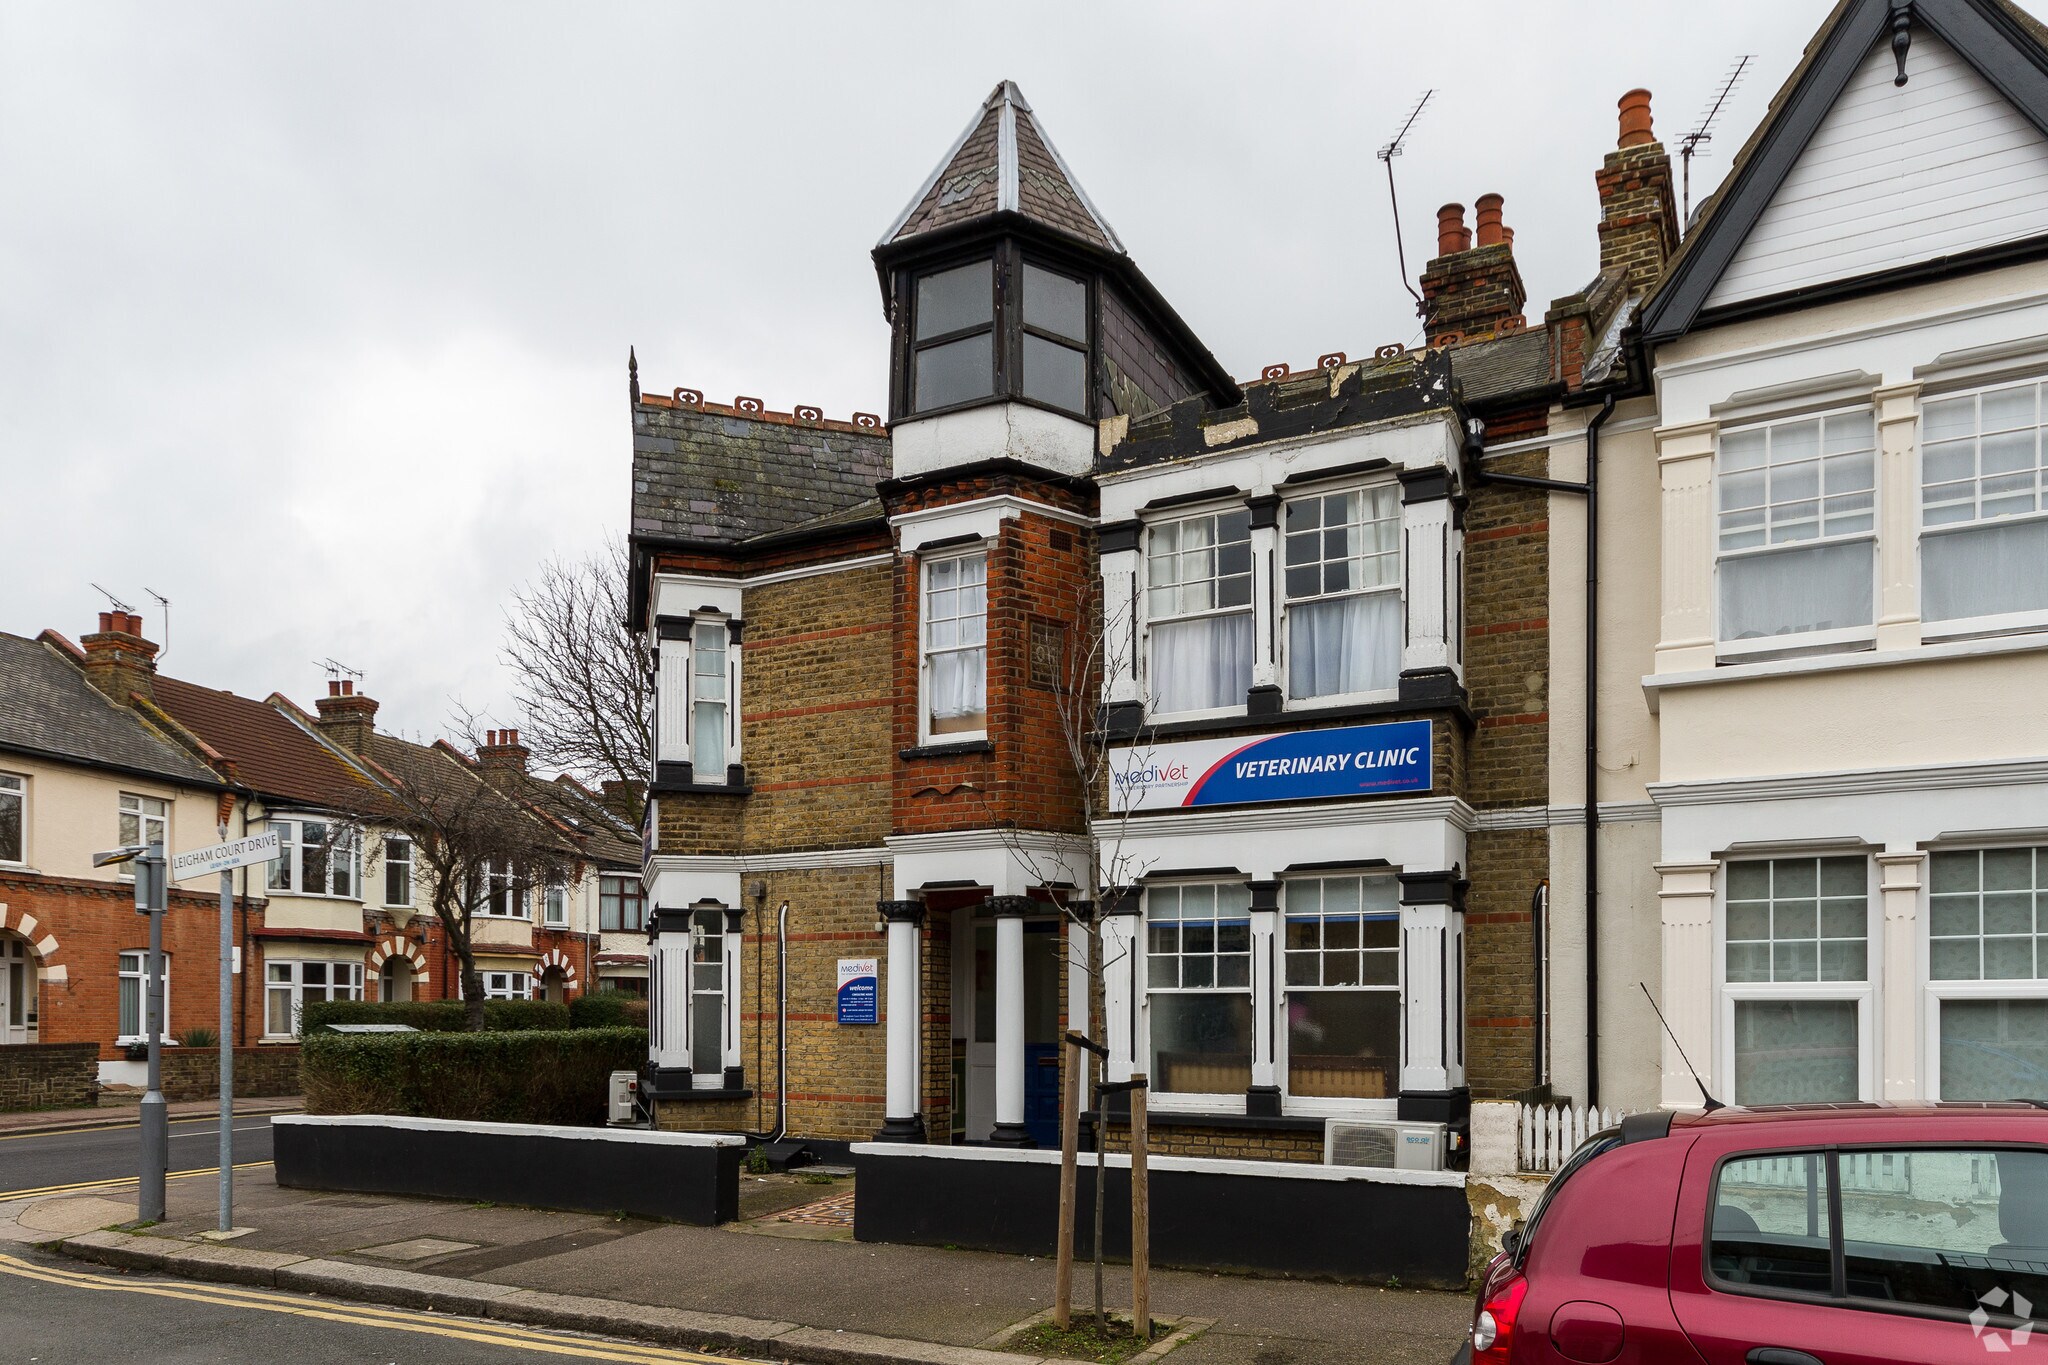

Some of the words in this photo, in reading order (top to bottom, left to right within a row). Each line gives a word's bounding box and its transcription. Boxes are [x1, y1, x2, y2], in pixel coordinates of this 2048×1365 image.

[1236, 753, 1352, 779] VETERINARY
[1354, 747, 1420, 769] CLINIC
[1359, 777, 1419, 787] www.medivet.co.uk
[173, 850, 213, 869] LEIGHAM
[215, 842, 246, 859] COURT
[248, 834, 277, 851] DRIVE
